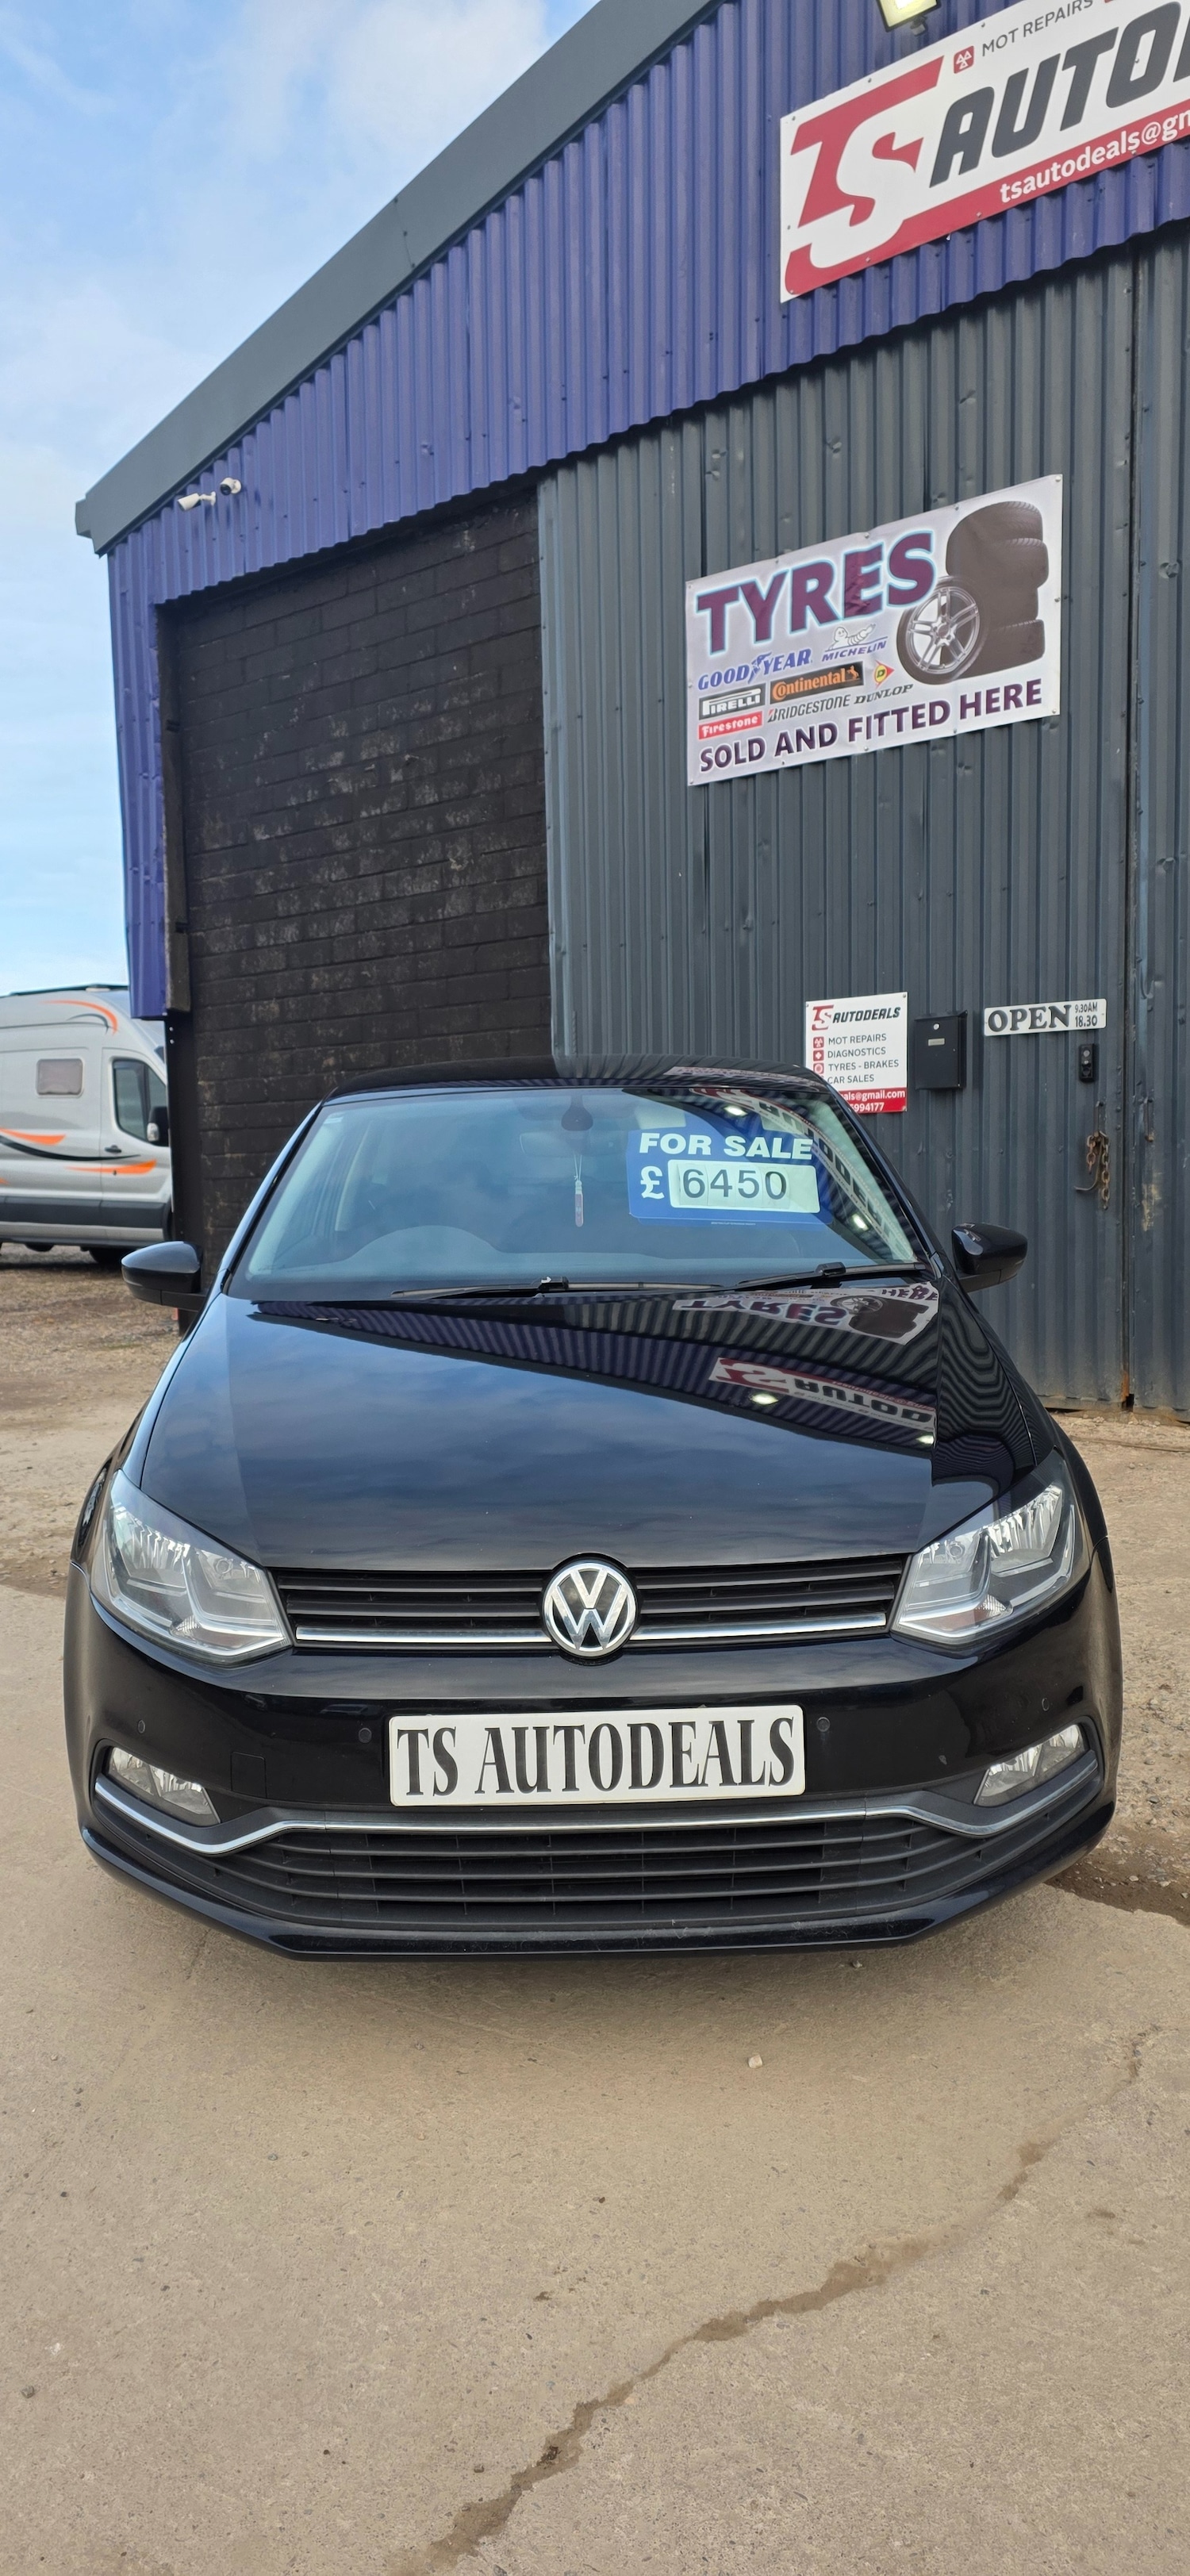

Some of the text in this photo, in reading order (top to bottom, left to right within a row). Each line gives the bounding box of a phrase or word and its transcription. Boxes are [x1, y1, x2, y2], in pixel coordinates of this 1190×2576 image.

[982, 0, 1093, 56] MOT REPAIRS
[785, 2, 1190, 295] TS AUTO
[697, 530, 936, 655] TYRES
[822, 640, 887, 662] MICHELIN
[772, 668, 846, 701] Continental
[854, 684, 914, 704] DUNLOP
[702, 688, 762, 716] PIRELLI
[767, 694, 851, 723] BRIDGESTONE
[700, 678, 1042, 772] SOLD AND FITTED HERE
[701, 715, 759, 738] Firestone
[812, 1004, 900, 1031] TS AUTODEALS
[988, 1004, 1072, 1032] OPEN
[1075, 1002, 1098, 1013] 9.30AM
[1075, 1015, 1098, 1027] 18.30
[827, 1046, 886, 1058] DIAGNOSTICS
[828, 1033, 887, 1046] MOT REPAIRS
[827, 1074, 874, 1085] CAR SALES
[828, 1062, 857, 1072] TYRES
[864, 1059, 899, 1069] BRAKES
[639, 1132, 813, 1161] FOR SALE
[682, 1169, 788, 1200] 6450
[551, 1567, 630, 1651] VW
[397, 1716, 794, 1798] TS AUTODEALS
